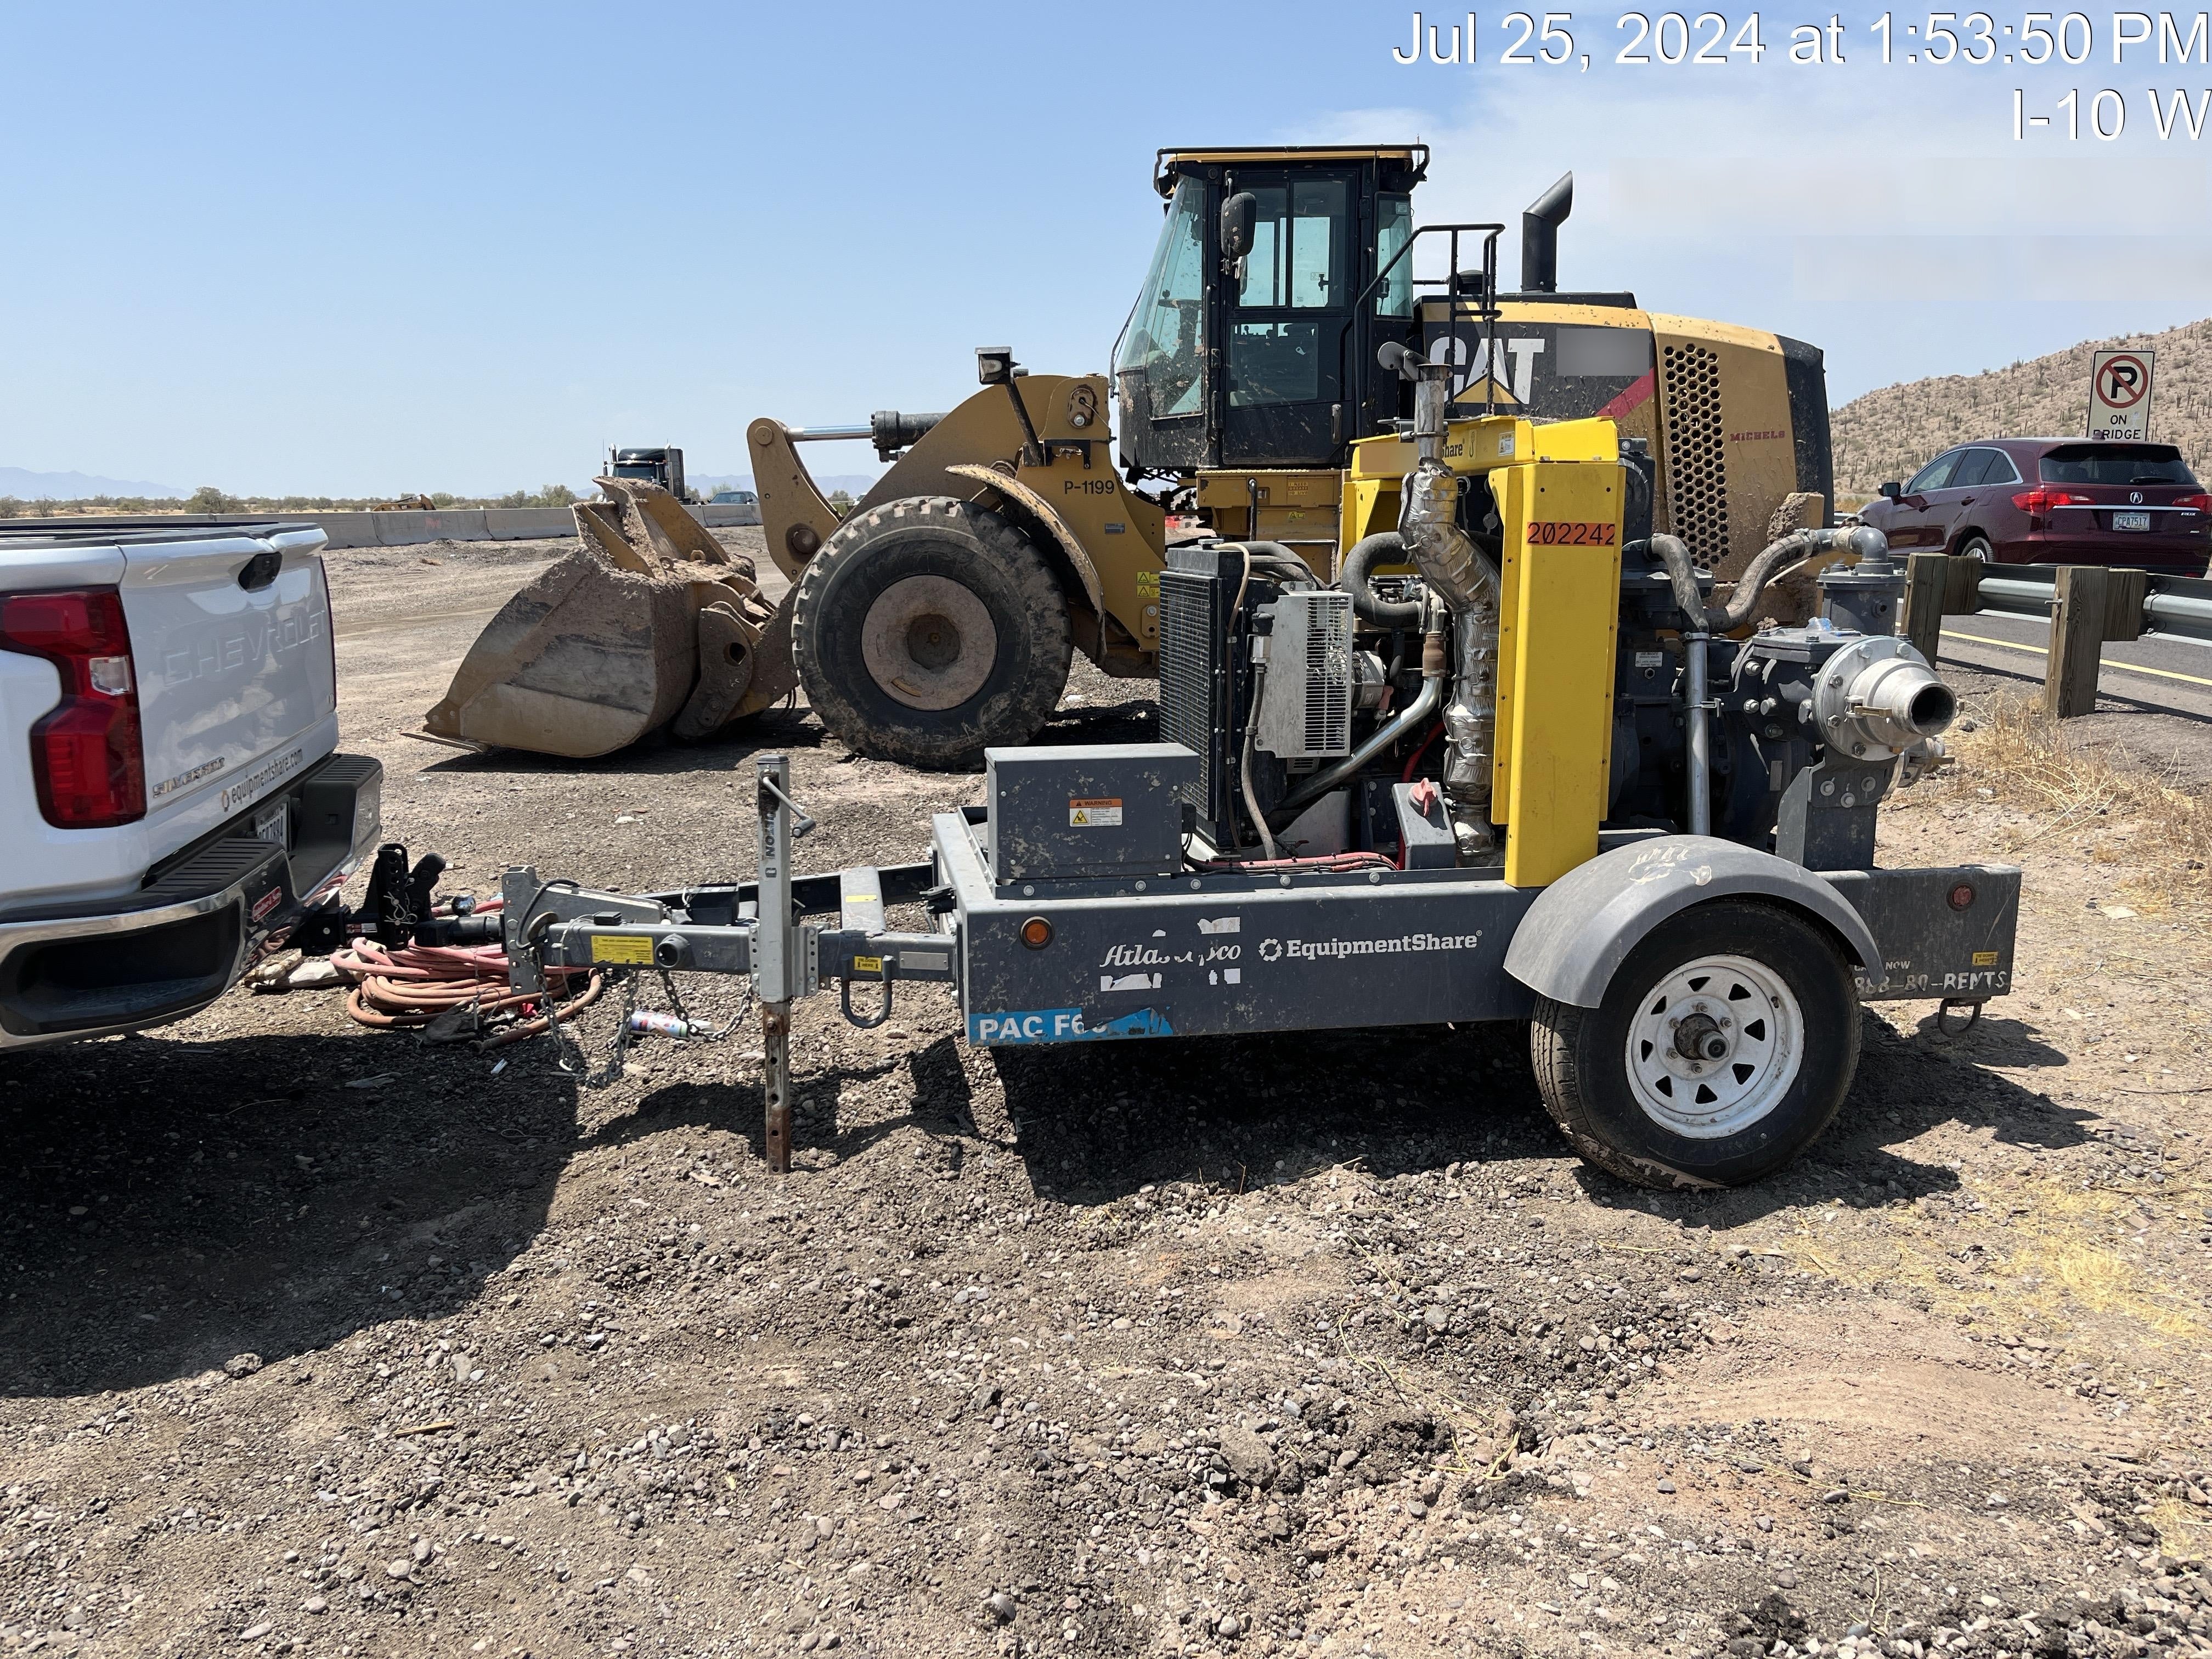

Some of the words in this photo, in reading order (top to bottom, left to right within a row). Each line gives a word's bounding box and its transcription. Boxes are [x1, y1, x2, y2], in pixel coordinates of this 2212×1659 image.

[1430, 336, 1545, 404] CAT
[2110, 414, 2127, 425] ON
[1064, 480, 1115, 495] P-1199
[2118, 517, 2147, 527] CPA7517
[1527, 522, 1615, 545] 202242
[1885, 961, 1911, 970] NOW
[979, 1015, 1043, 1040] PAC
